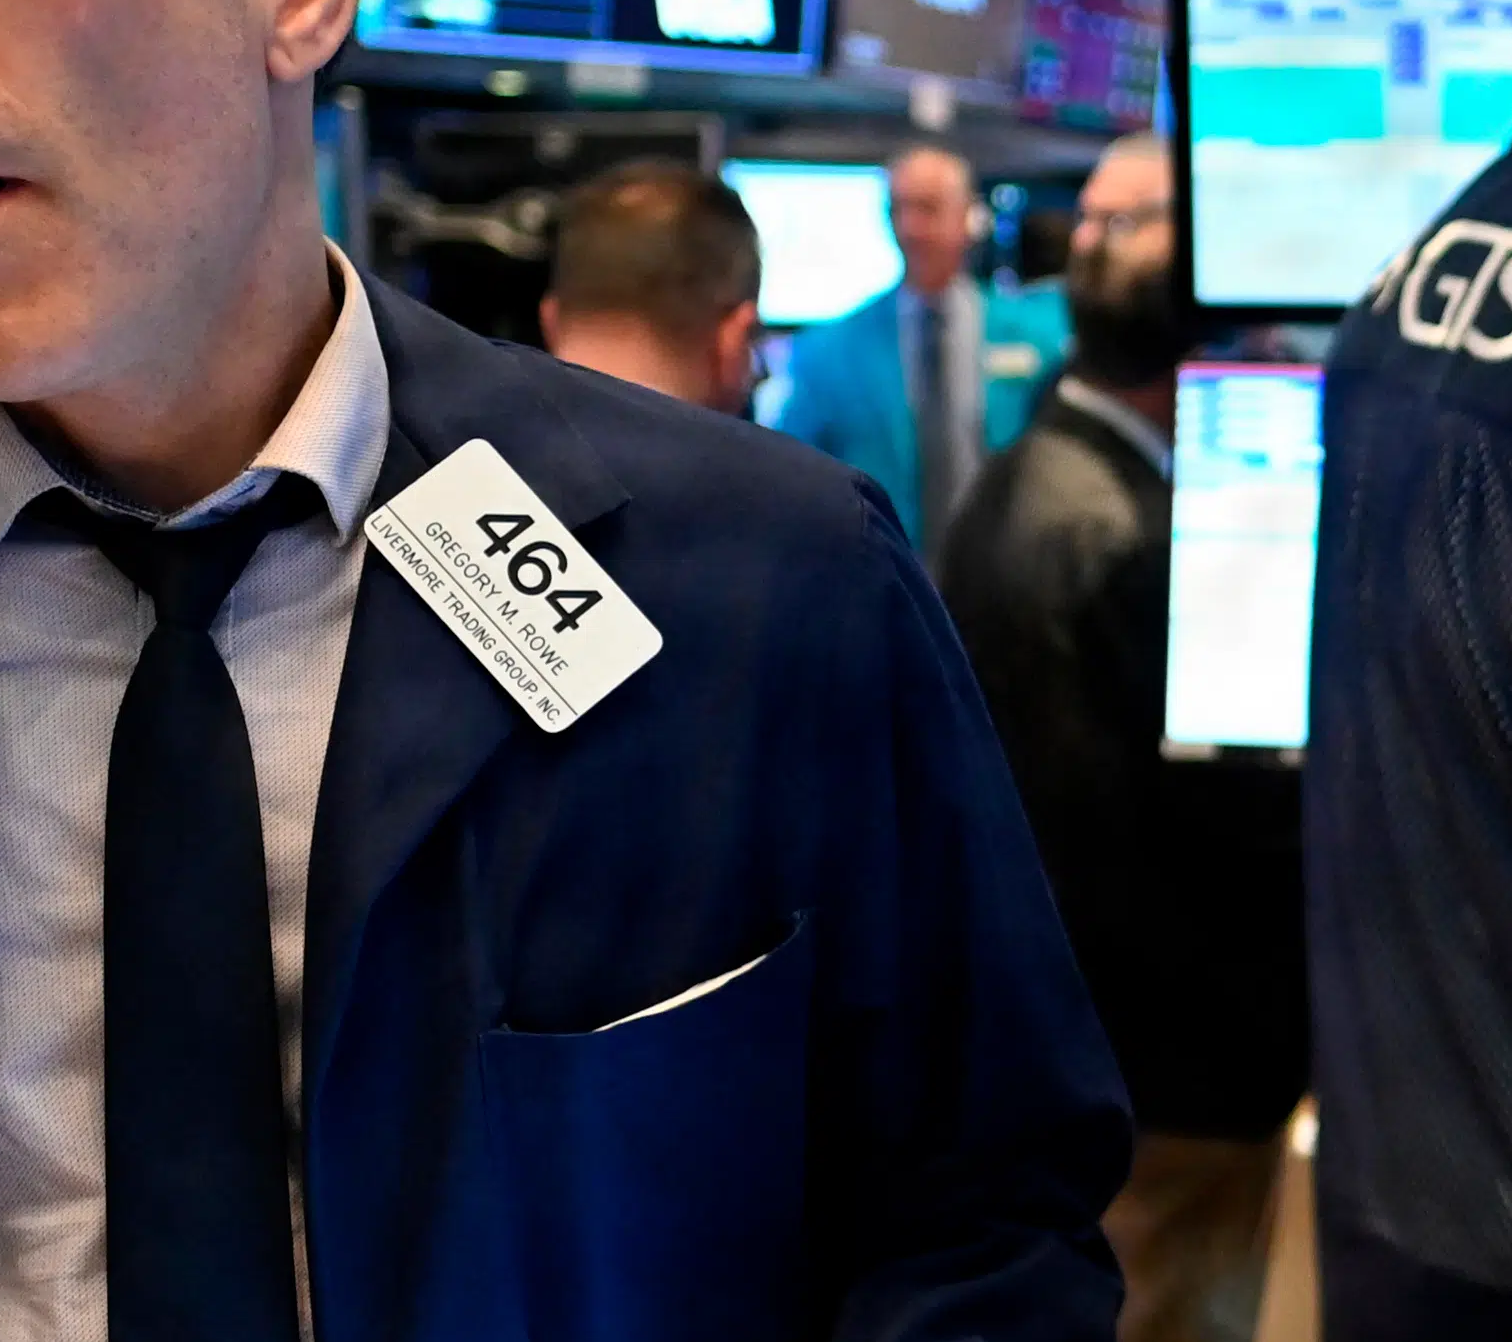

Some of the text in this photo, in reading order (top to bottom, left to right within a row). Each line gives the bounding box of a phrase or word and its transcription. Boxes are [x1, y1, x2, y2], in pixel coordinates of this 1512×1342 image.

[370, 514, 445, 594] LIVERMORE
[442, 591, 497, 650] TRADING
[536, 696, 562, 725] INC.
[425, 521, 569, 677] GREGORY M. ROWE
[475, 513, 604, 635] 464
